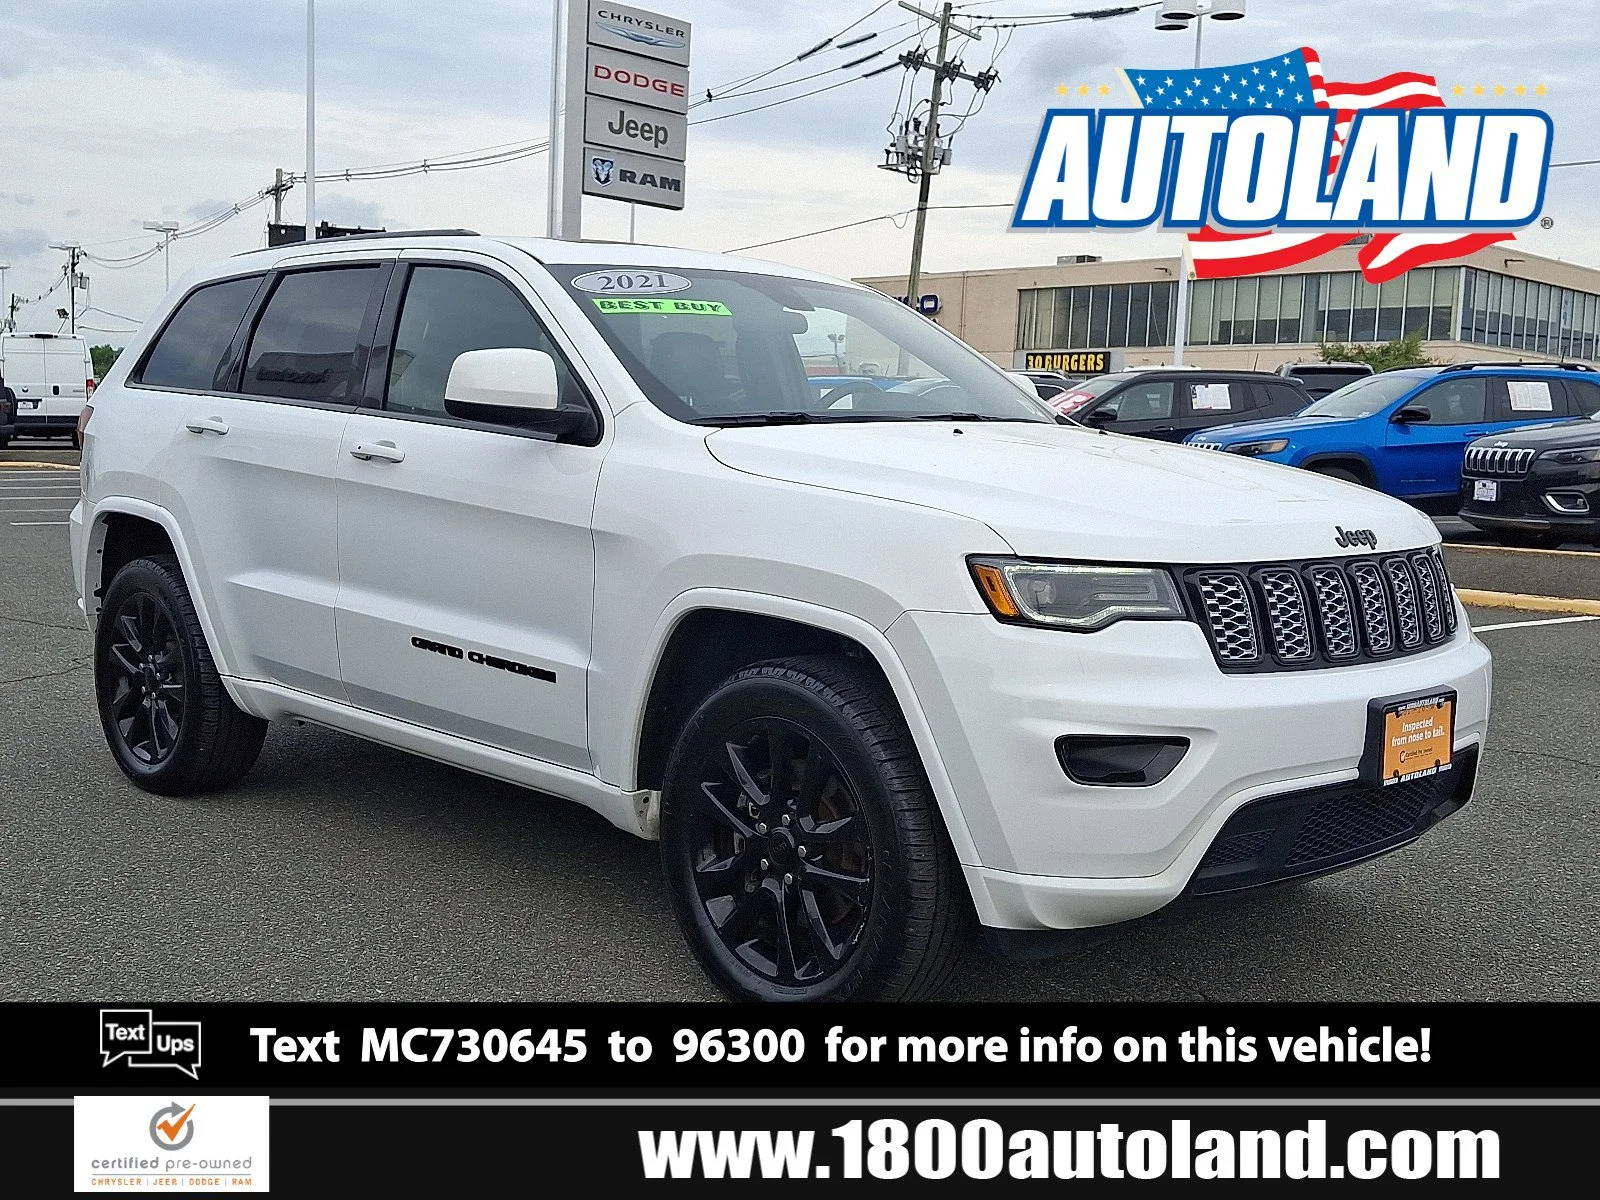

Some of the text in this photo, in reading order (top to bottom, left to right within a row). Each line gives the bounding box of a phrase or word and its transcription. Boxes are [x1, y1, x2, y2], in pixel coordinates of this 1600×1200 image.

[597, 10, 685, 38] CHRYSLER
[594, 65, 685, 97] DODGE
[607, 110, 669, 148] Jeep
[619, 169, 681, 192] RAM
[597, 274, 670, 291] 2021
[600, 300, 722, 312] BEST BUY
[1335, 526, 1378, 550] Jeep
